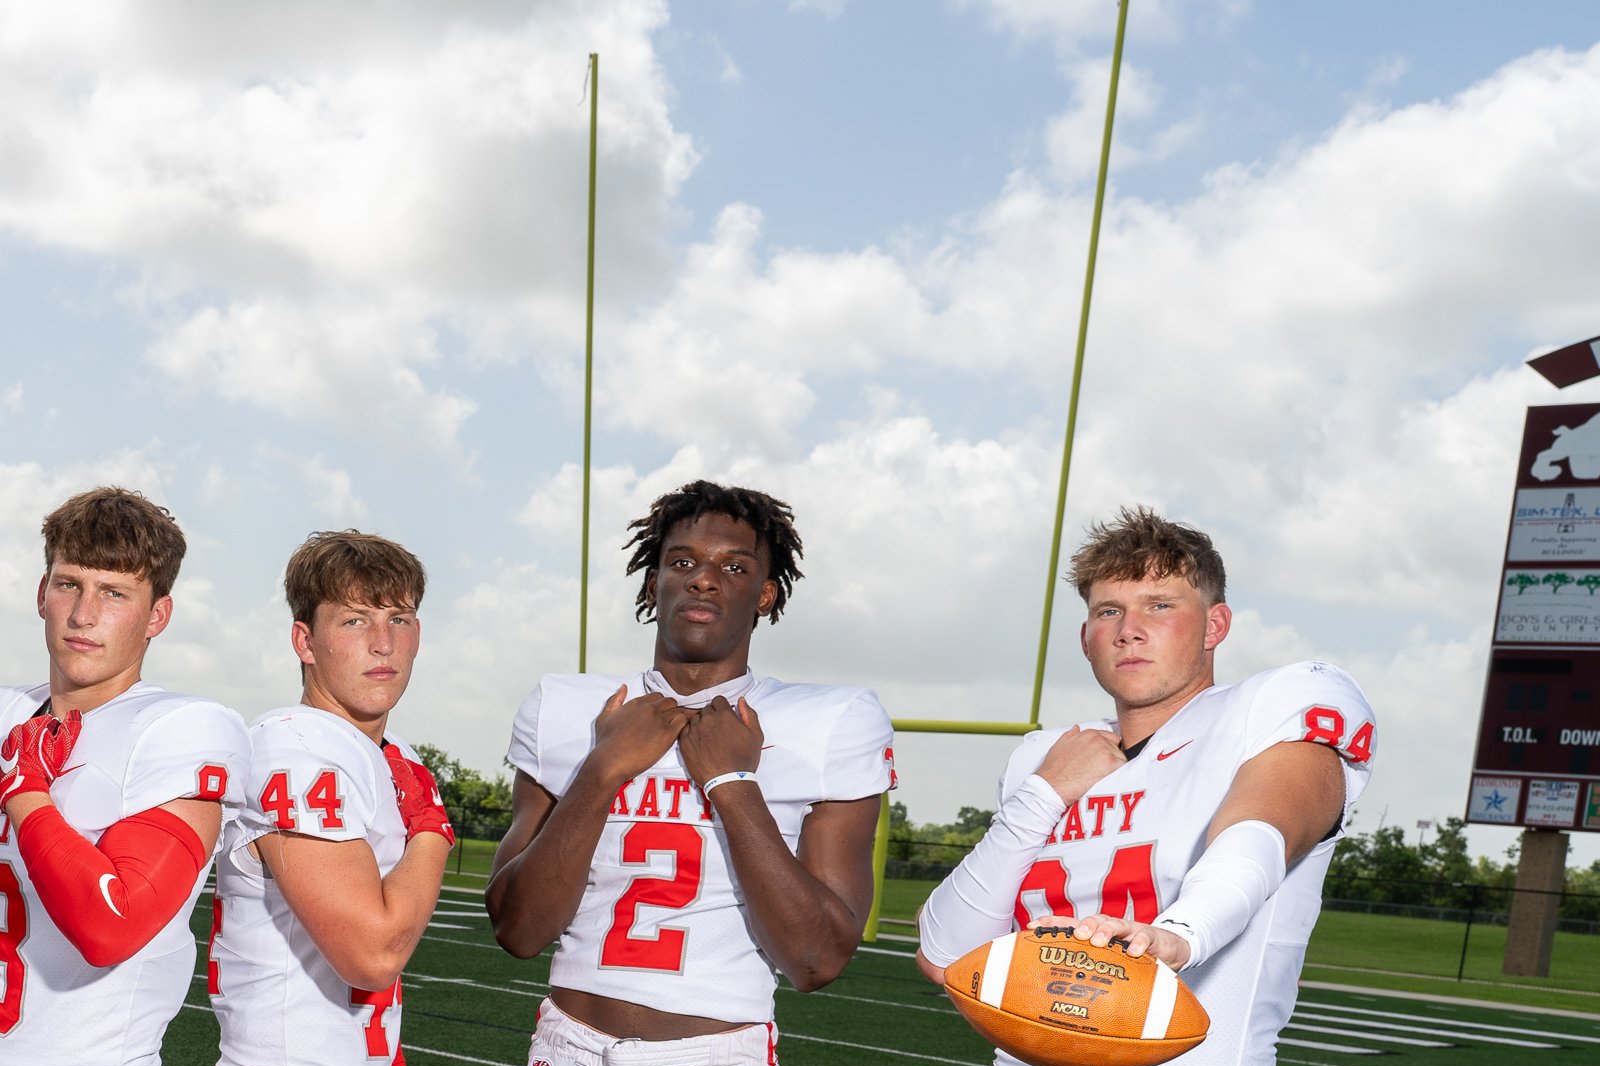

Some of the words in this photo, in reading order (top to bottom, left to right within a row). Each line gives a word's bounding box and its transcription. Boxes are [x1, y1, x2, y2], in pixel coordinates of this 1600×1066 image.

[1501, 614, 1541, 625] BOYS
[1301, 704, 1376, 766] 84
[1502, 727, 1538, 744] T.O.L.
[258, 767, 347, 832] 44
[598, 820, 708, 977] 2
[1038, 944, 1130, 982] Wilson
[1045, 979, 1109, 1003] GST
[1049, 1001, 1090, 1019] NCAA
